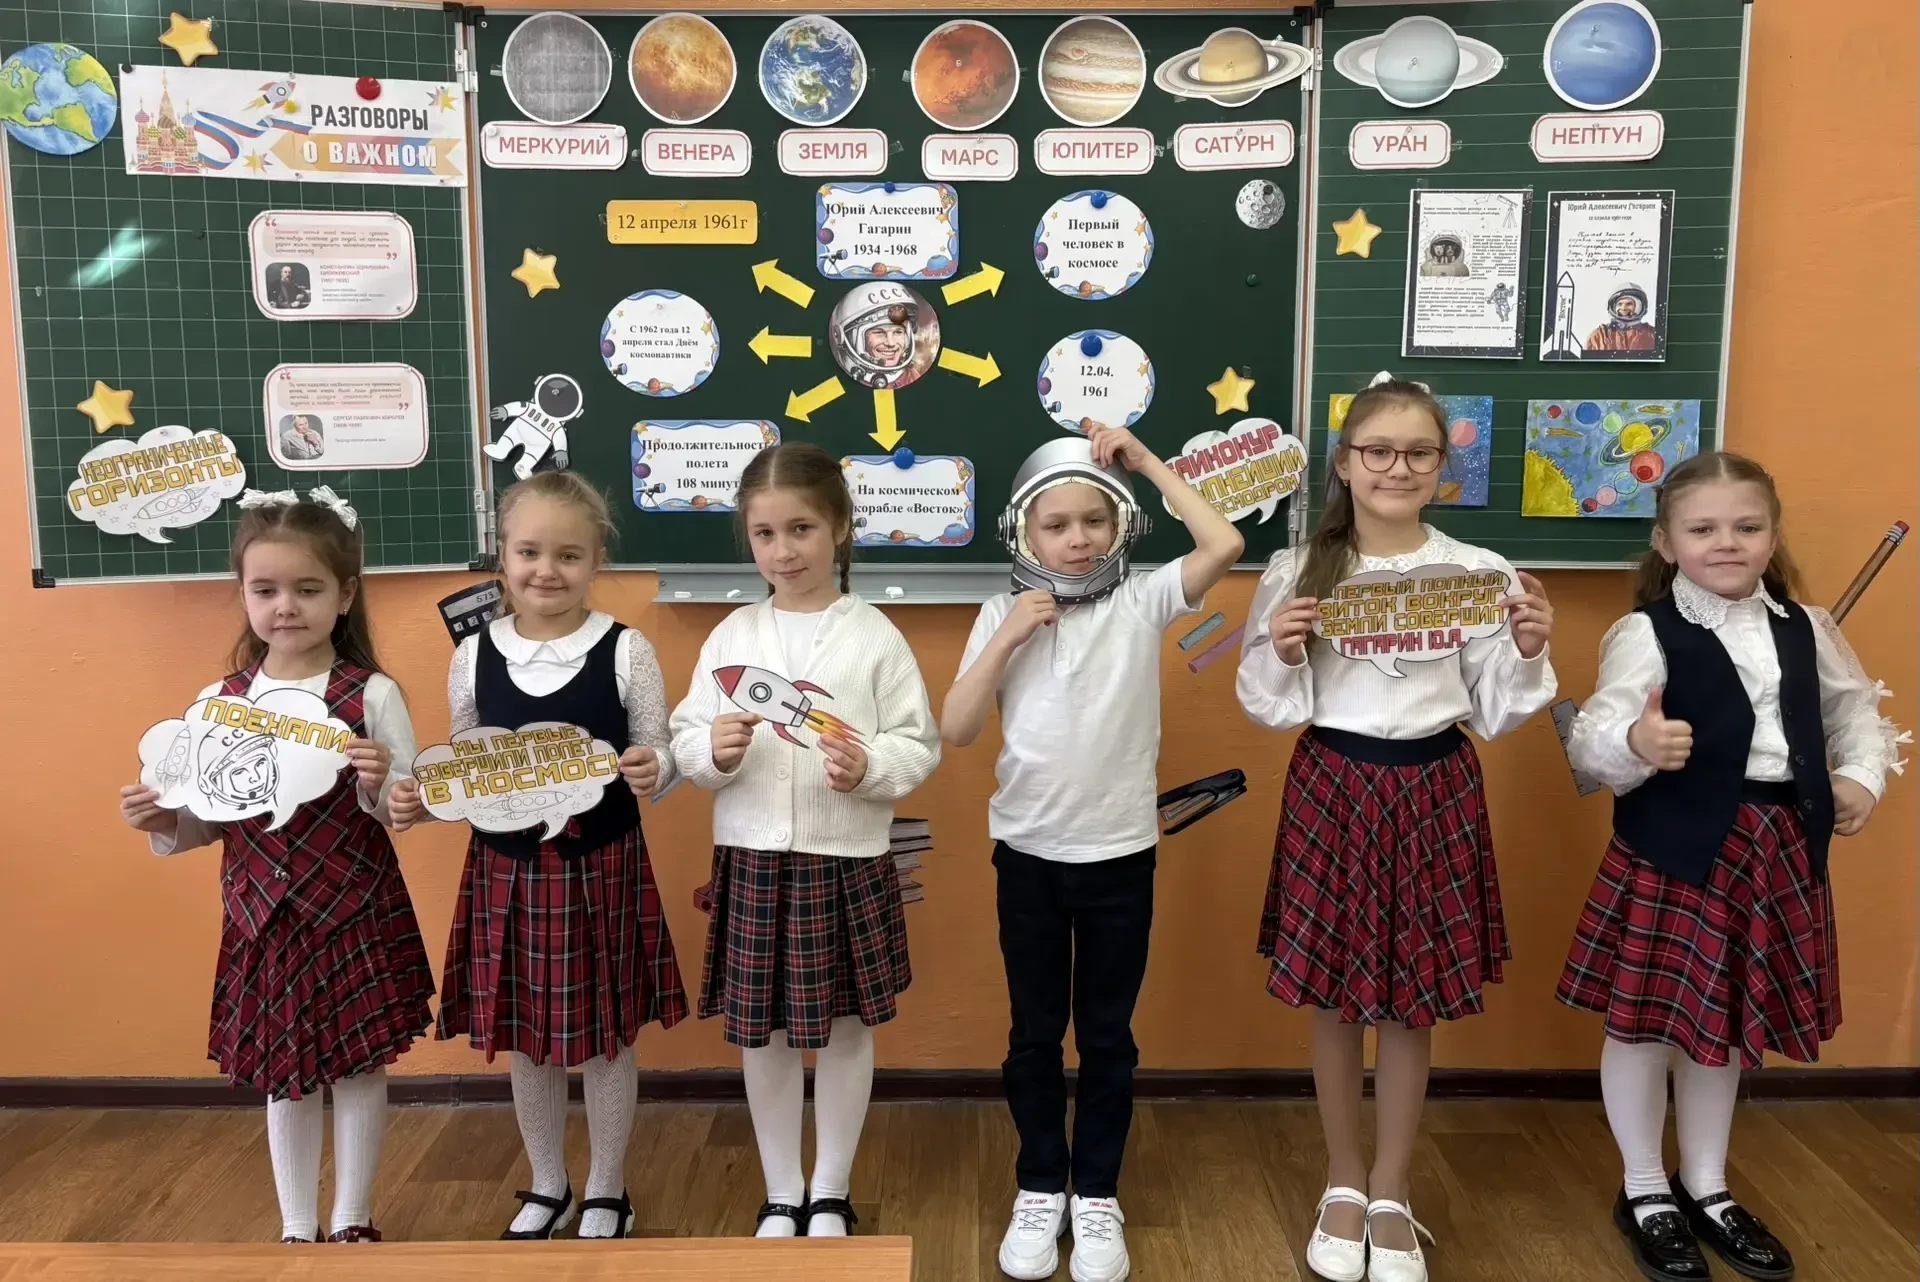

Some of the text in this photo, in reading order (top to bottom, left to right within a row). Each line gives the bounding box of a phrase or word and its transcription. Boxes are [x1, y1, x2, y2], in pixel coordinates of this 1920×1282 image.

[310, 104, 429, 131] РАЗГОВОРЫ
[499, 134, 610, 155] МЕРКУРИЙ
[1194, 135, 1275, 154] САТУРН
[1372, 135, 1428, 153] УРАН
[1551, 125, 1643, 146] НЕПТУН
[303, 141, 438, 168] О ВАЖНОМ
[657, 143, 736, 161] ВЕНЕРА
[798, 142, 868, 160] ЗЕМЛЯ
[941, 149, 999, 166] МАРС
[1052, 141, 1139, 159] ЮПИТЕР
[826, 203, 944, 217] Юрий Алексеевич
[1567, 203, 1587, 212] Юрий
[1588, 203, 1627, 211] Алексеевич
[618, 214, 748, 232] 12 апреля 1961г
[858, 223, 912, 237] Гагарин
[1068, 218, 1120, 233] Первый
[853, 244, 918, 256] 1934 -1968
[1062, 239, 1124, 250] человек в
[1068, 258, 1119, 269] космосе
[629, 325, 691, 335] С 1962 года 12
[622, 337, 699, 348] апреля стал Днём
[629, 351, 692, 360] космонавтики
[1080, 364, 1114, 378] 12.04.
[1081, 385, 1109, 398] 1961
[80, 433, 228, 484] НЕОГРАНИЧЕННЫЕ
[1166, 424, 1279, 480] АЙКОНУР
[686, 460, 729, 468] полета
[69, 453, 242, 511] ГОРИЗОНТЫ
[677, 478, 697, 488] 108
[858, 485, 960, 496] На космическом
[854, 503, 964, 516] корабле «Восток»
[1334, 570, 1504, 600] ПЕРВЫЙ ПОЛНЫЙ
[476, 591, 495, 603] 573
[1316, 587, 1504, 620] ВИТОК ВОКРУГ
[1321, 604, 1505, 637] ЗЕМЛИ СОВЕРШИЛ
[1340, 629, 1466, 657] ГАГАРИН Ю.А.
[202, 697, 358, 753] ПОЕХАЛИ
[451, 725, 581, 758] МЫ ПЕРВЫЕ
[413, 737, 594, 784] СОВЕРШИЛИ ПОЛЕТ
[424, 752, 619, 806] В КОСМОС!
